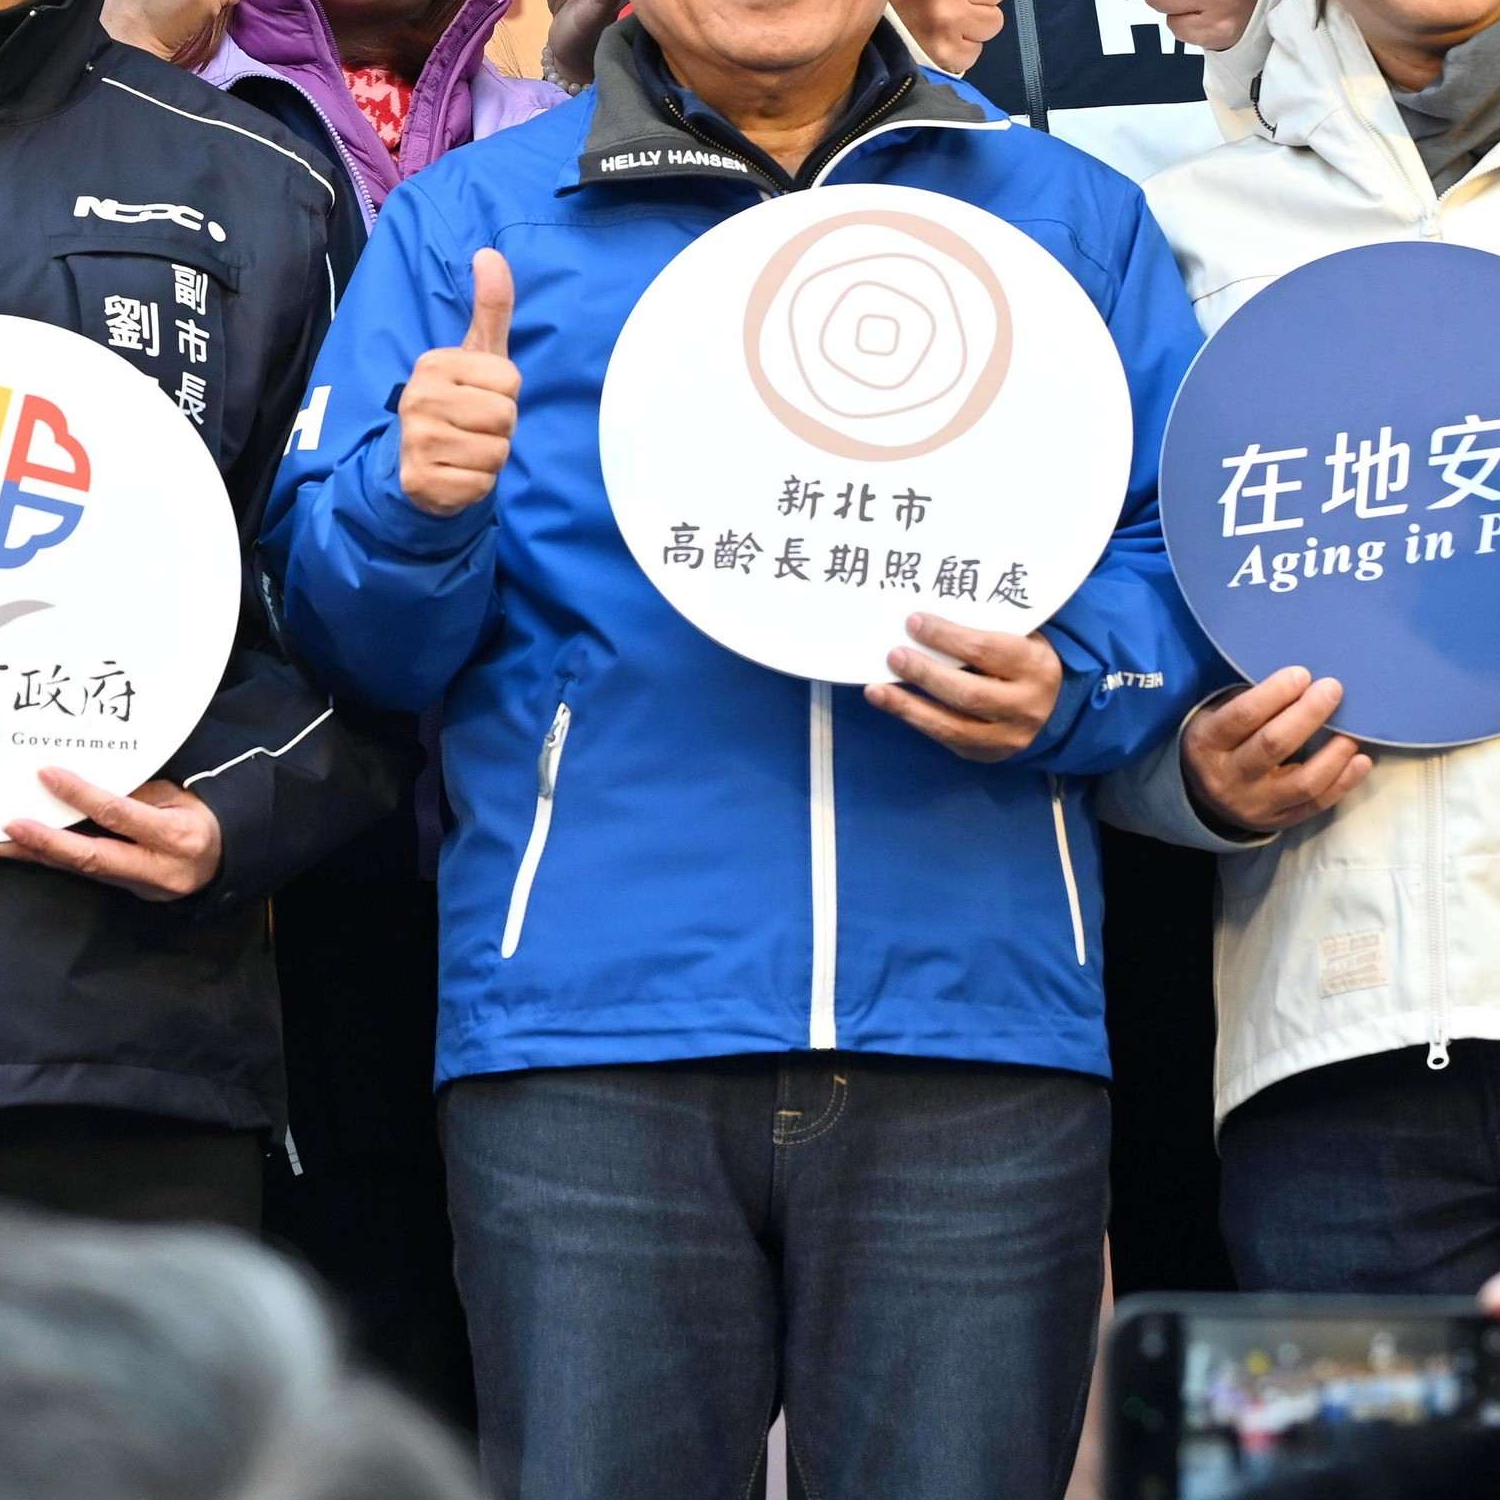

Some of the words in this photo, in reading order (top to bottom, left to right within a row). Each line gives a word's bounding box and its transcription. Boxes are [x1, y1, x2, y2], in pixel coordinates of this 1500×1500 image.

[601, 150, 662, 172] HELLY
[667, 149, 749, 173] HANSEN
[103, 294, 161, 358] 劉
[171, 263, 211, 426] 副市長
[776, 474, 933, 531] 新北市
[661, 522, 1034, 610] 高齡長期照顧處
[1227, 537, 1386, 593] Aging
[1405, 523, 1455, 565] in
[11, 731, 139, 750] Government
